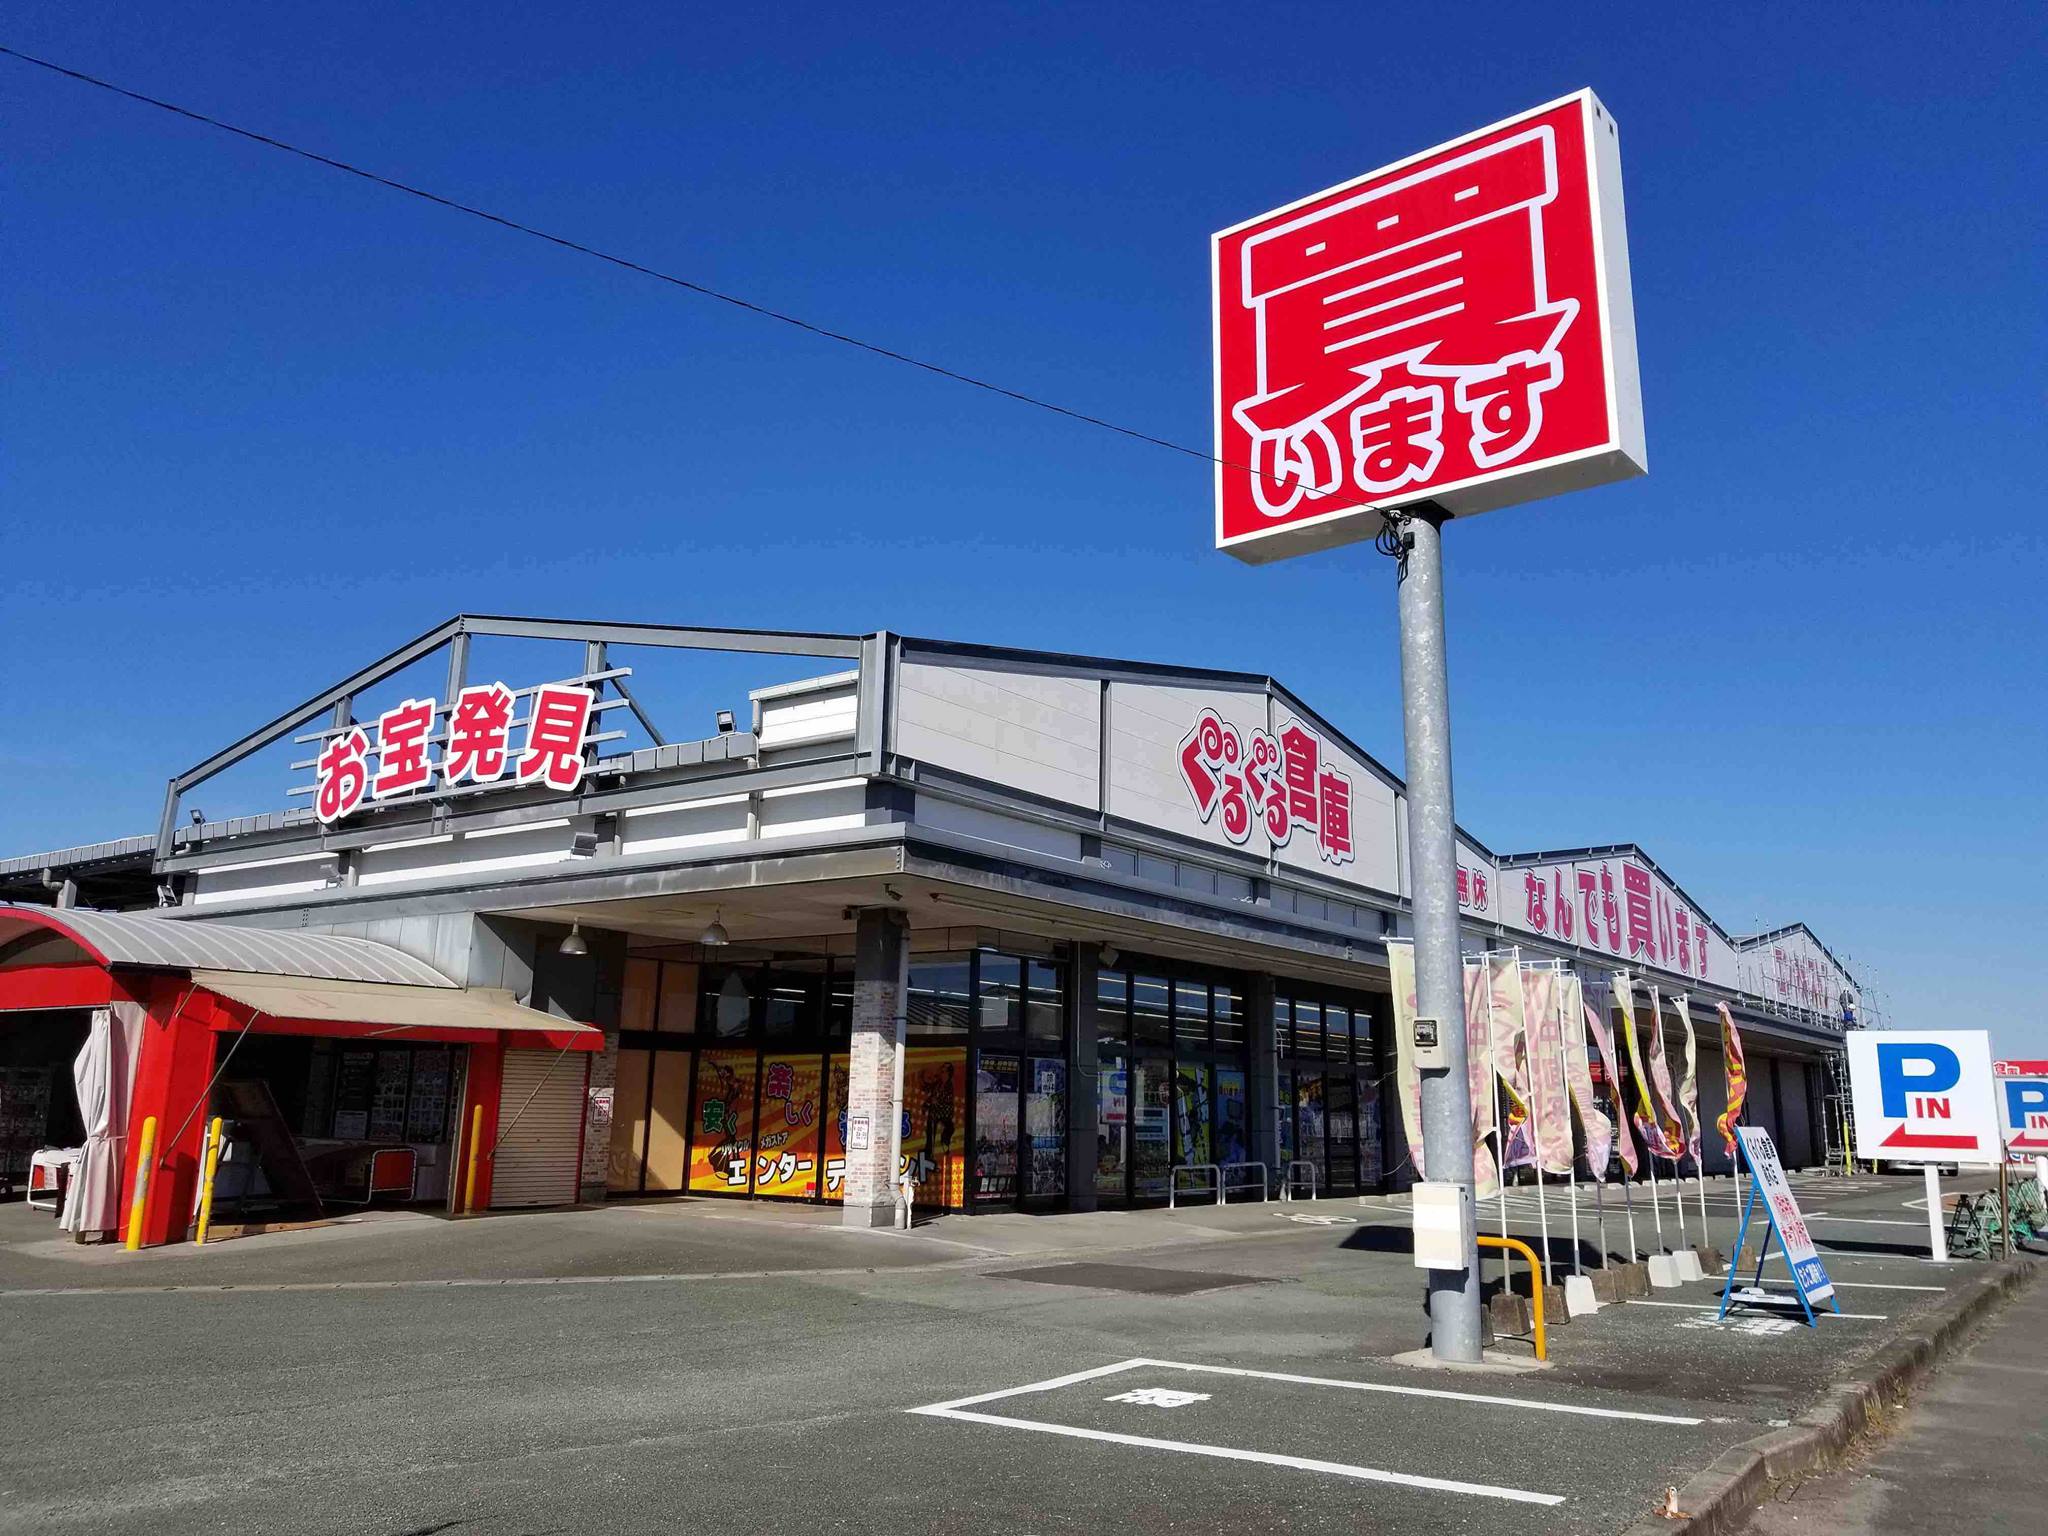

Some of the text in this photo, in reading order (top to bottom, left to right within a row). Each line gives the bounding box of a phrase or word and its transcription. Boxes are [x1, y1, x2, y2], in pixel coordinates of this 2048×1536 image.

[315, 680, 595, 824] お宝発見
[1179, 710, 1354, 862] ぐるぐる倉庫
[1524, 860, 1709, 979] なんでも買います
[1877, 1043, 1961, 1118] P
[1915, 1098, 1951, 1118] IN
